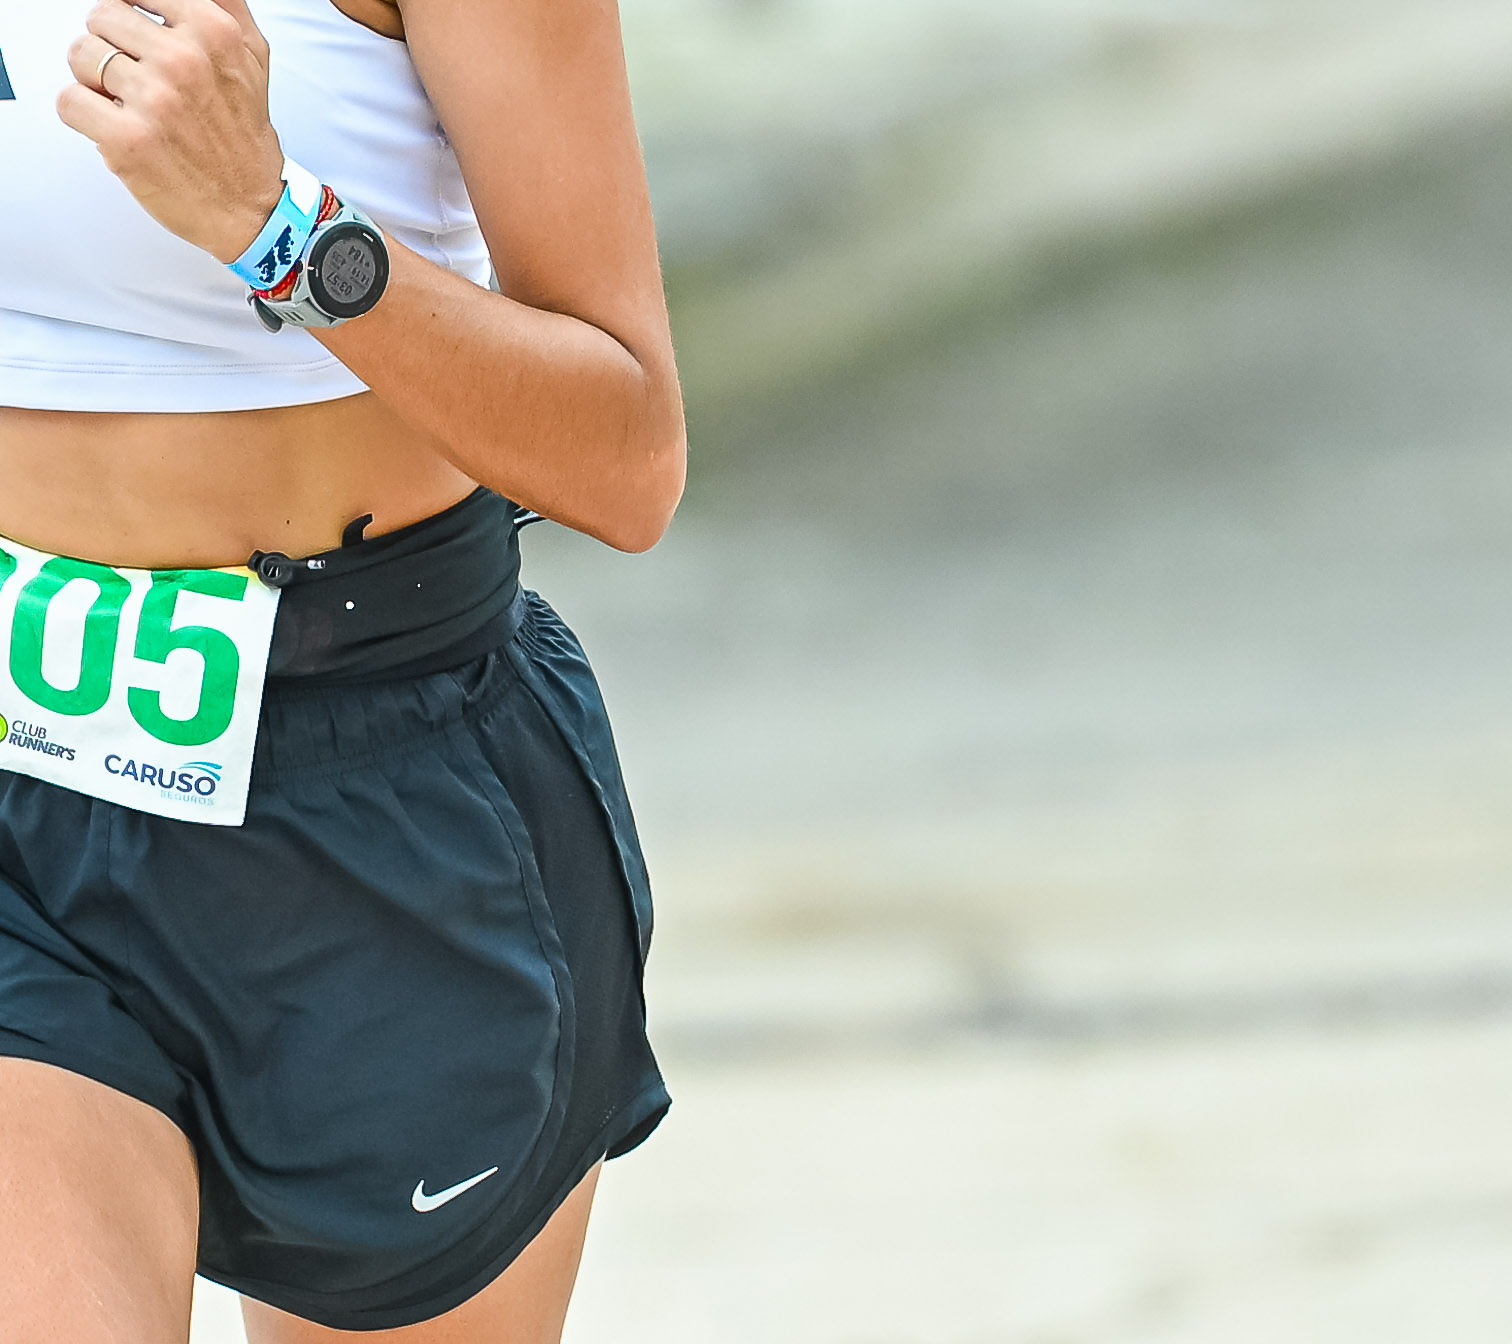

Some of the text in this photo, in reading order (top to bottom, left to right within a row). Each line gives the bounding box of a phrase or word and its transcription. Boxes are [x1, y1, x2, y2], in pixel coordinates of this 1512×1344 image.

[12, 720, 47, 739] CLUB
[9, 733, 76, 761] RUNNER'S
[104, 754, 216, 797] CARUSO
[160, 790, 216, 807] SEGUROS
